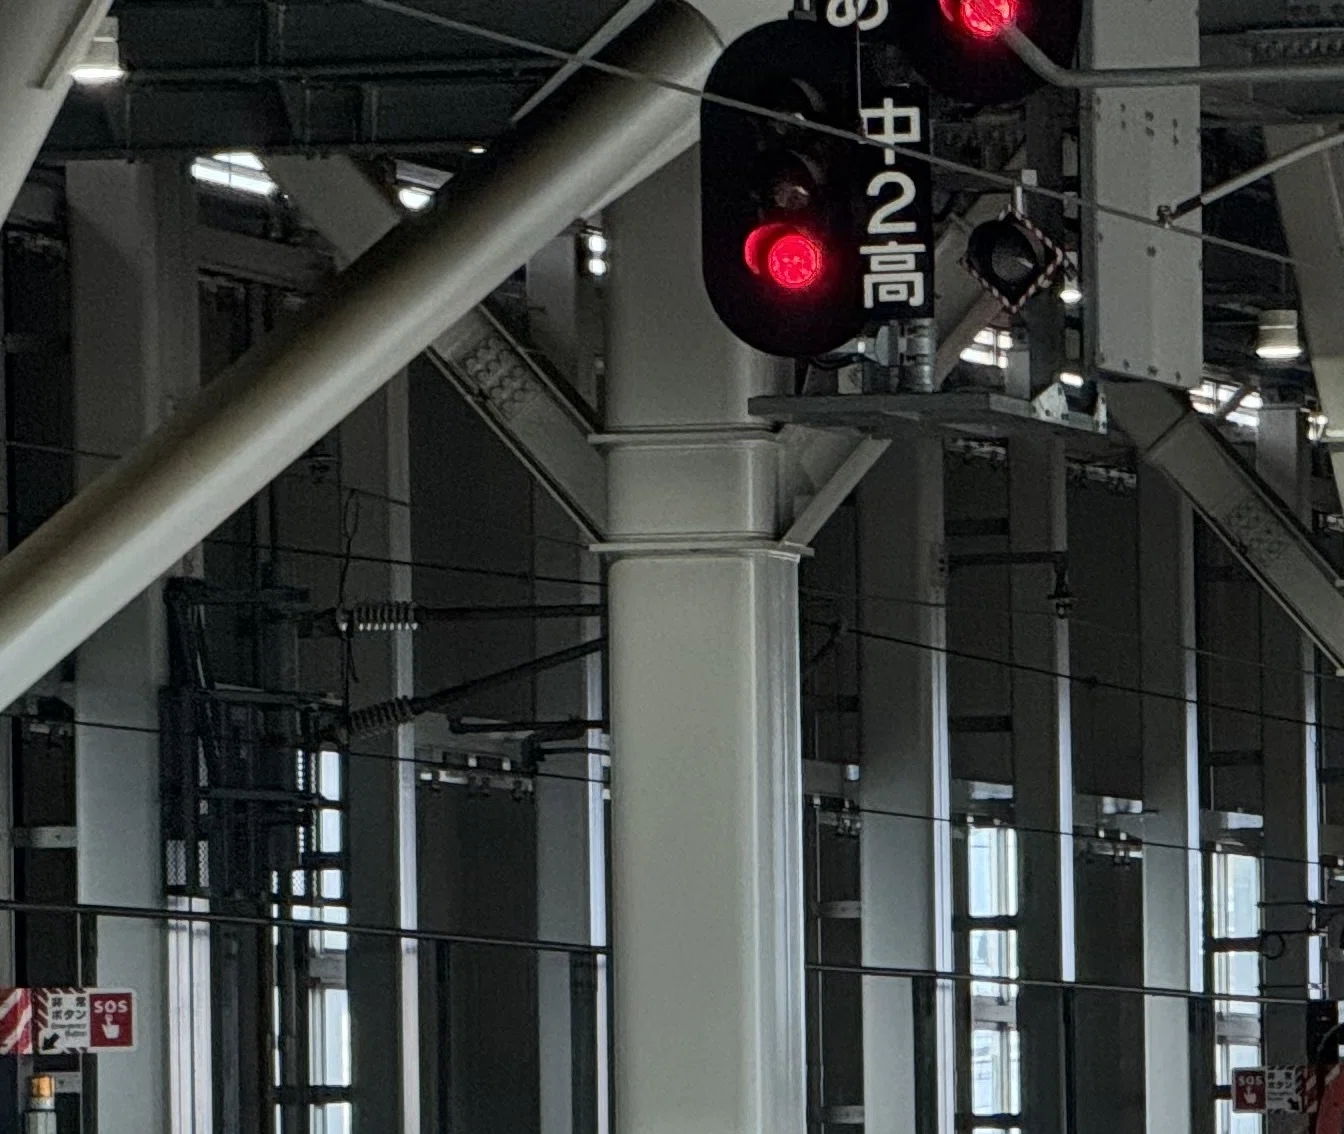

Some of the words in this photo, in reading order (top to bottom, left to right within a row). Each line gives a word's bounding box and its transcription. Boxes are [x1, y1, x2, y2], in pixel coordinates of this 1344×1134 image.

[858, 97, 926, 309] 中2高
[94, 1000, 128, 1013] SOS
[51, 1010, 86, 1020] ボタン
[1238, 1075, 1264, 1086] SOS
